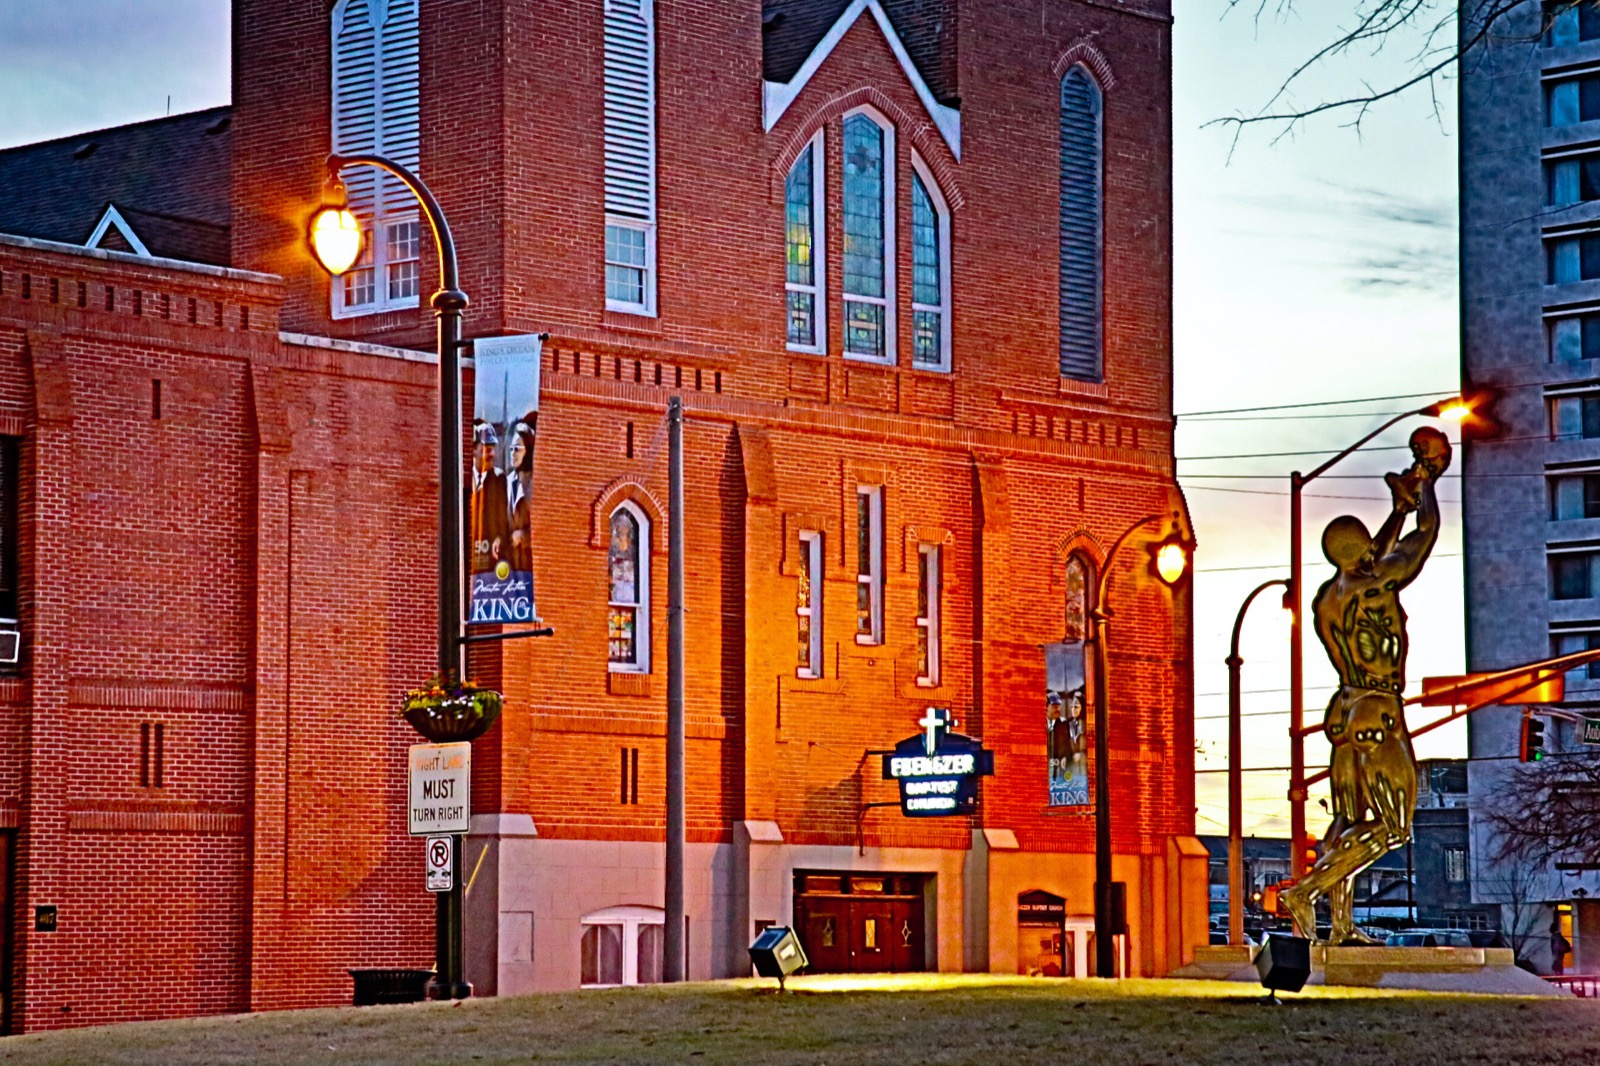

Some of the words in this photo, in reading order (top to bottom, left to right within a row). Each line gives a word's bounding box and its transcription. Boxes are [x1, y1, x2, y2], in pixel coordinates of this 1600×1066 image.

[474, 539, 490, 554] 50
[471, 596, 531, 621] KING
[415, 756, 439, 771] RIGHT
[442, 754, 463, 770] LANE
[890, 753, 975, 777] EBENEZER
[423, 778, 455, 800] MUST
[906, 780, 958, 796] BAPTIST
[1050, 790, 1088, 806] KING
[413, 807, 436, 822] TURN
[438, 805, 463, 820] RIGHT
